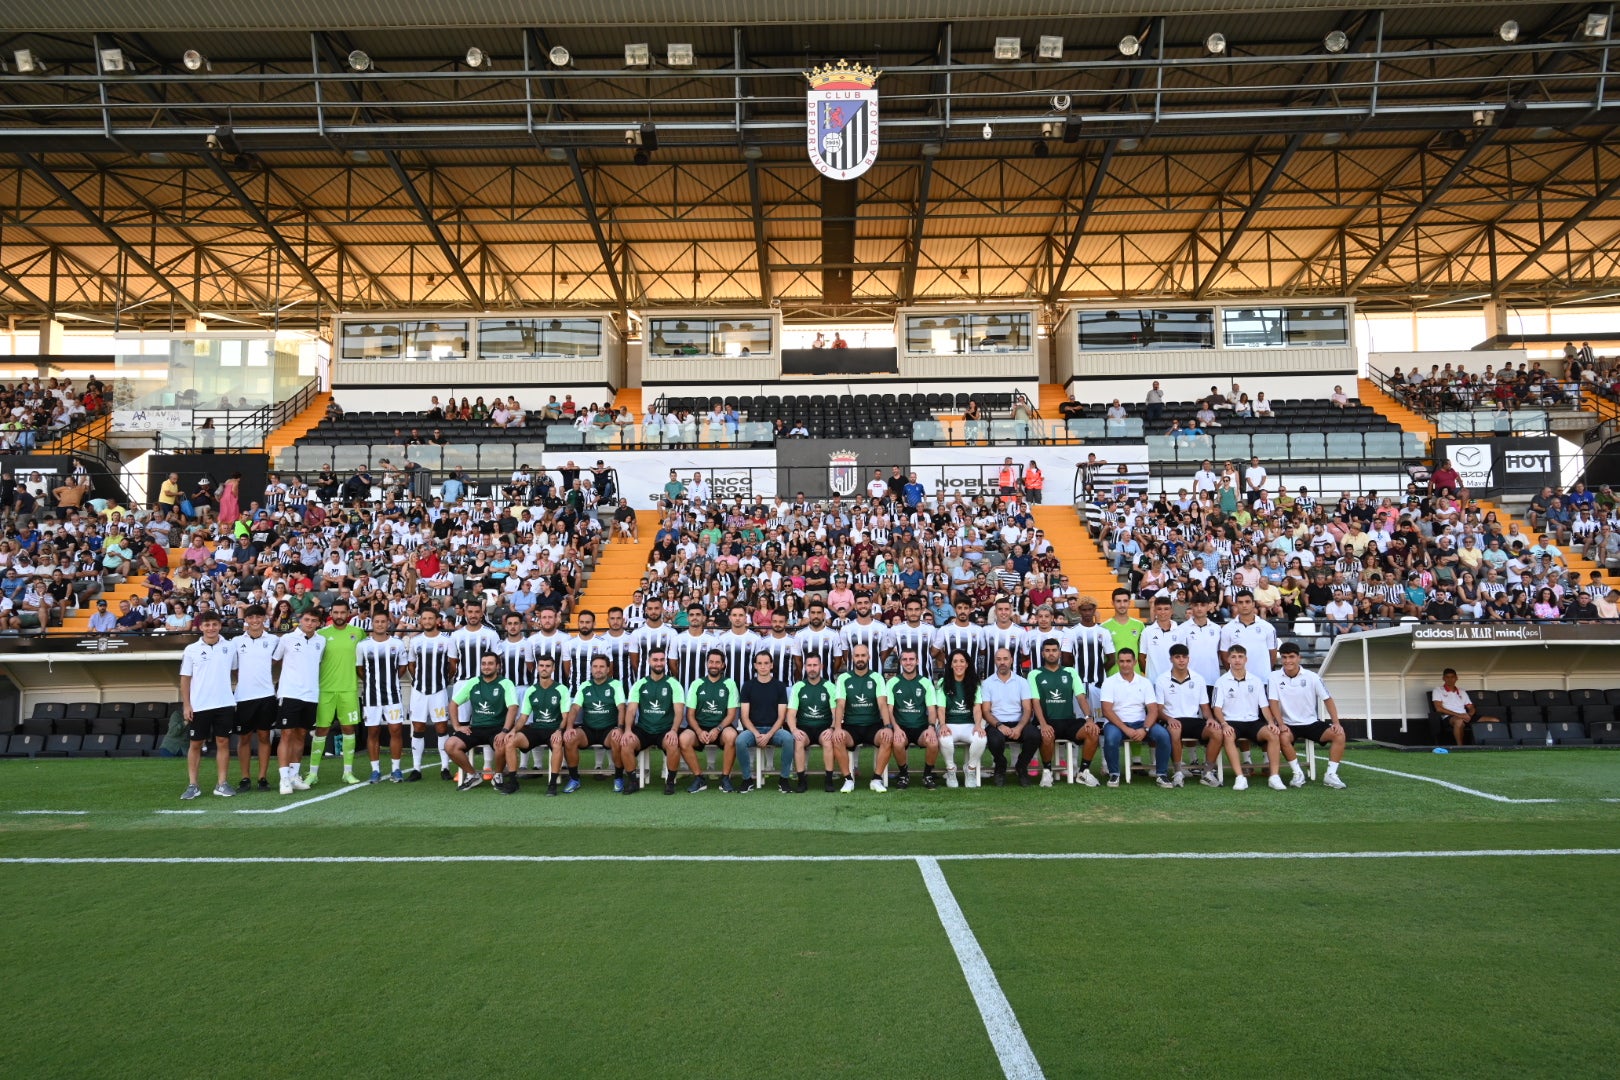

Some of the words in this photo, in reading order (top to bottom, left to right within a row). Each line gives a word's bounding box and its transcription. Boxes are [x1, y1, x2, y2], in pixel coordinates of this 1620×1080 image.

[808, 102, 828, 173] DEPORTIVO
[865, 101, 878, 166] BADAJOZ
[1507, 455, 1547, 468] HOY
[936, 478, 1000, 487] NOBLE
[1415, 628, 1454, 638] adidas
[1456, 627, 1468, 639] LA
[1471, 627, 1492, 639] MAR
[348, 711, 358, 722] 13
[389, 709, 400, 720] 17
[434, 707, 445, 719] 14
